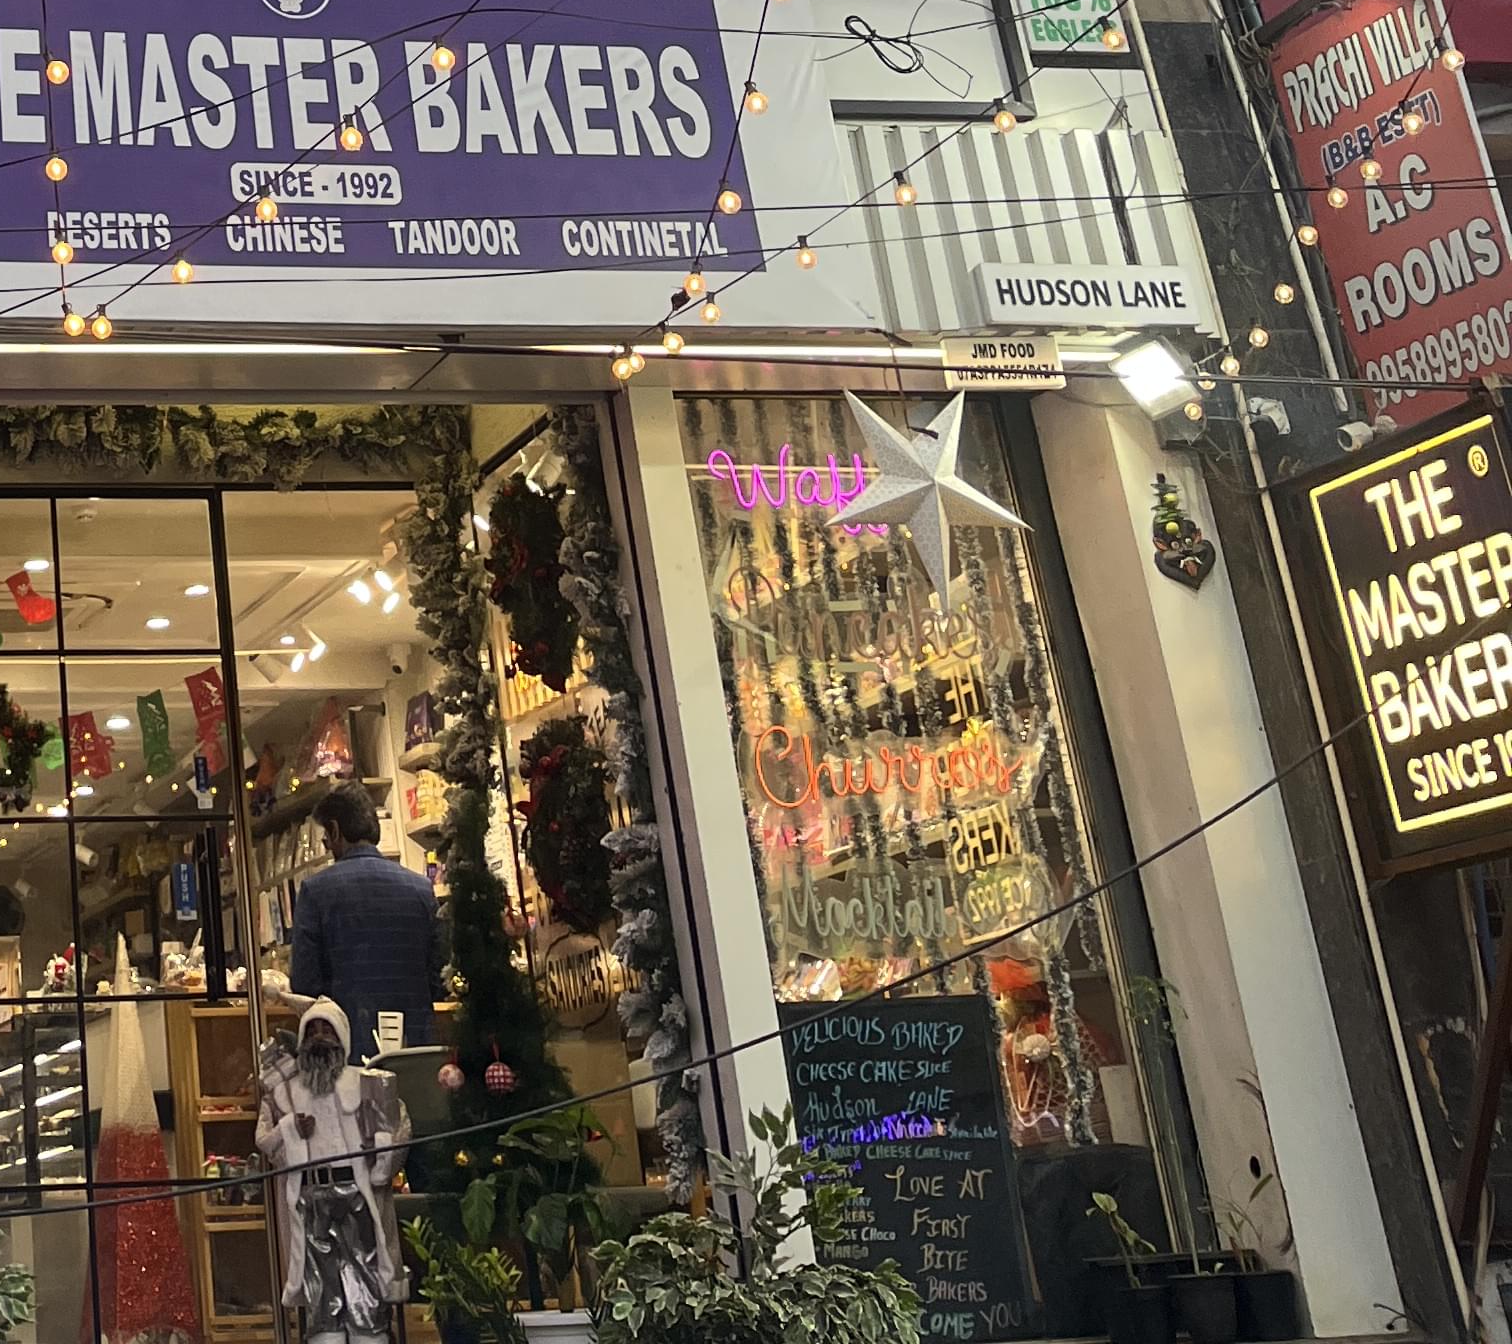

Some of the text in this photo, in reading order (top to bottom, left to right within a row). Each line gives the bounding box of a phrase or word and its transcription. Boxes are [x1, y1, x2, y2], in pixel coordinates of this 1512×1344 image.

[74, 28, 390, 151] MASTER
[407, 39, 712, 159] BAKERS
[1283, 31, 1373, 133] PRACHI
[239, 170, 314, 198] SINCE
[336, 172, 394, 199] 1992
[226, 215, 345, 253] CHINESE
[388, 219, 520, 256] TANDOOR
[996, 278, 1187, 308] HUDSON LANE
[1343, 217, 1500, 334] ROOMS
[972, 343, 1035, 359] JMD FOOD
[1364, 458, 1464, 553] THE
[756, 725, 1024, 808] Churros
[1407, 738, 1498, 802] SINCE
[957, 1168, 992, 1200] AT
[916, 1243, 969, 1273] BITE
